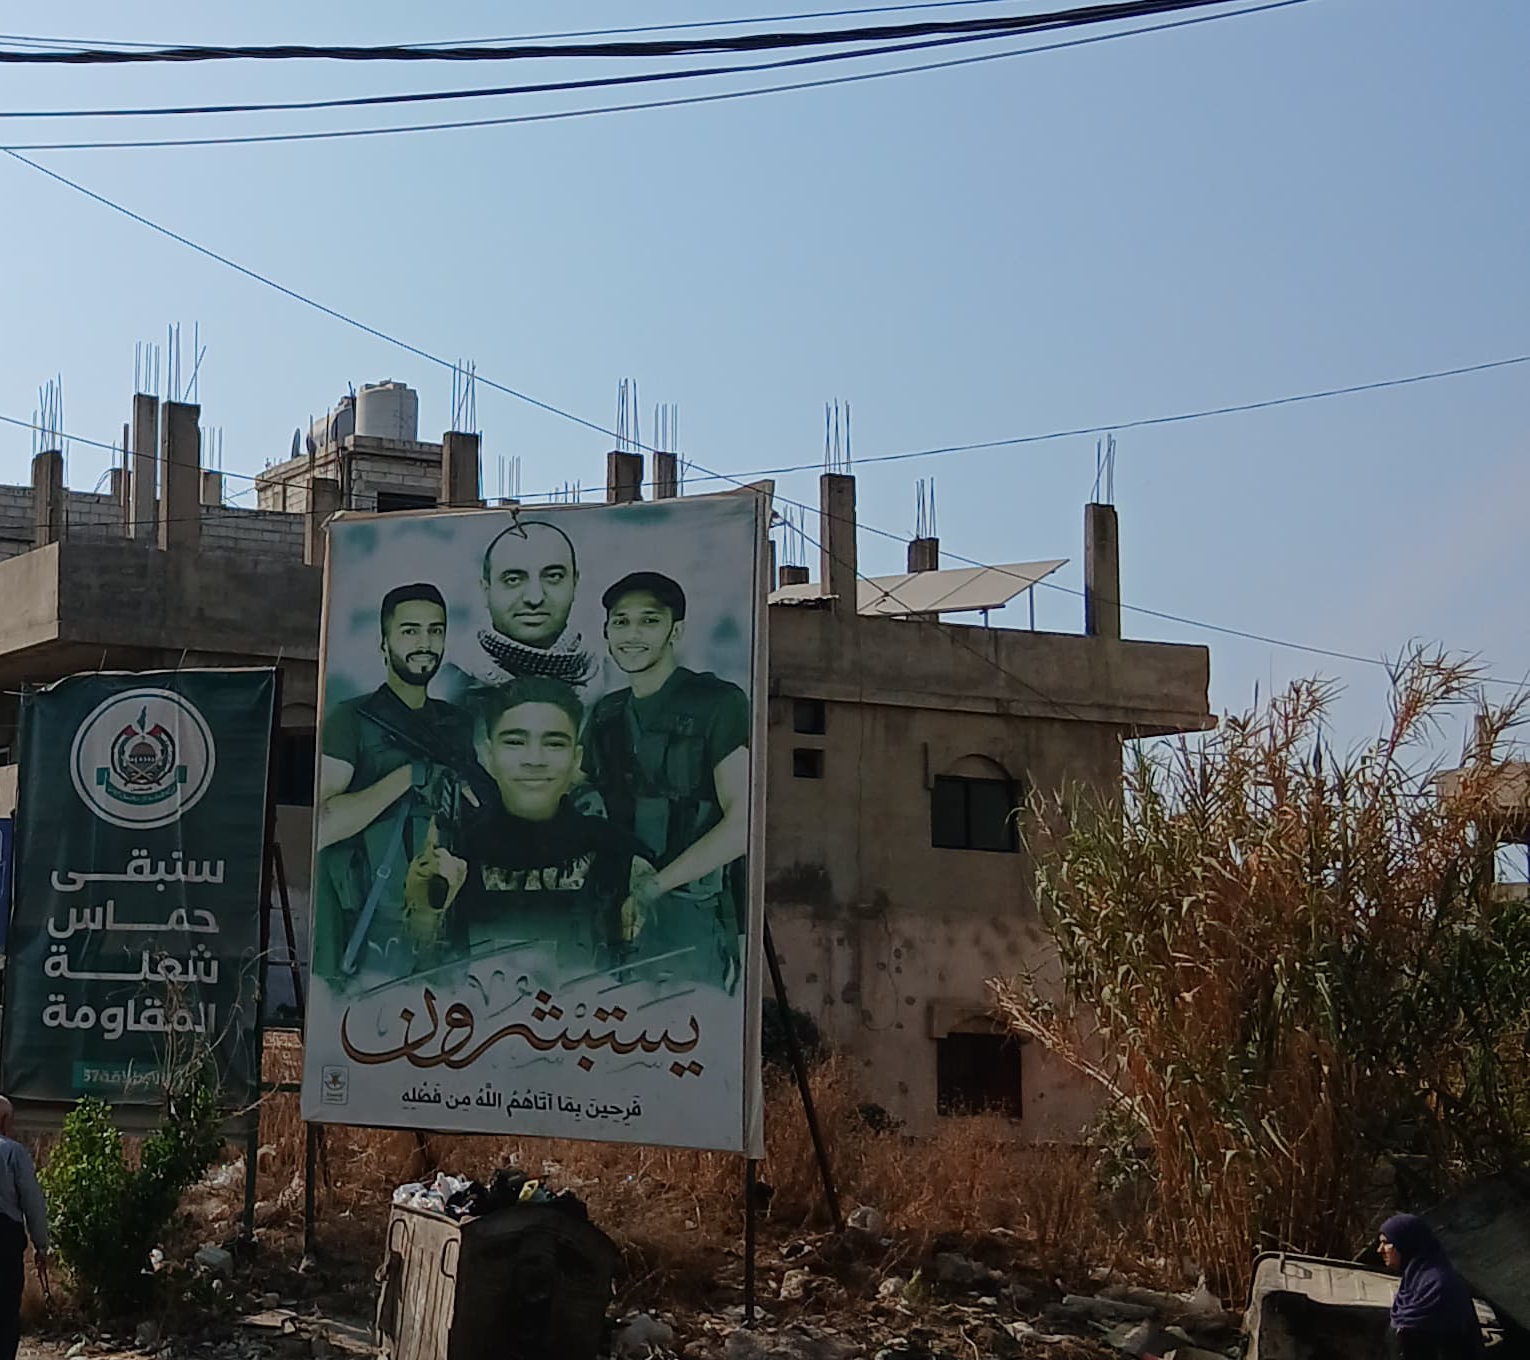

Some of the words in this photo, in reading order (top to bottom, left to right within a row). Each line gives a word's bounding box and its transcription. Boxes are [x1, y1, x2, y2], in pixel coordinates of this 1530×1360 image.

[47, 899, 220, 939] حماس
[44, 943, 219, 984] شعلة
[42, 993, 217, 1040] المقاومة
